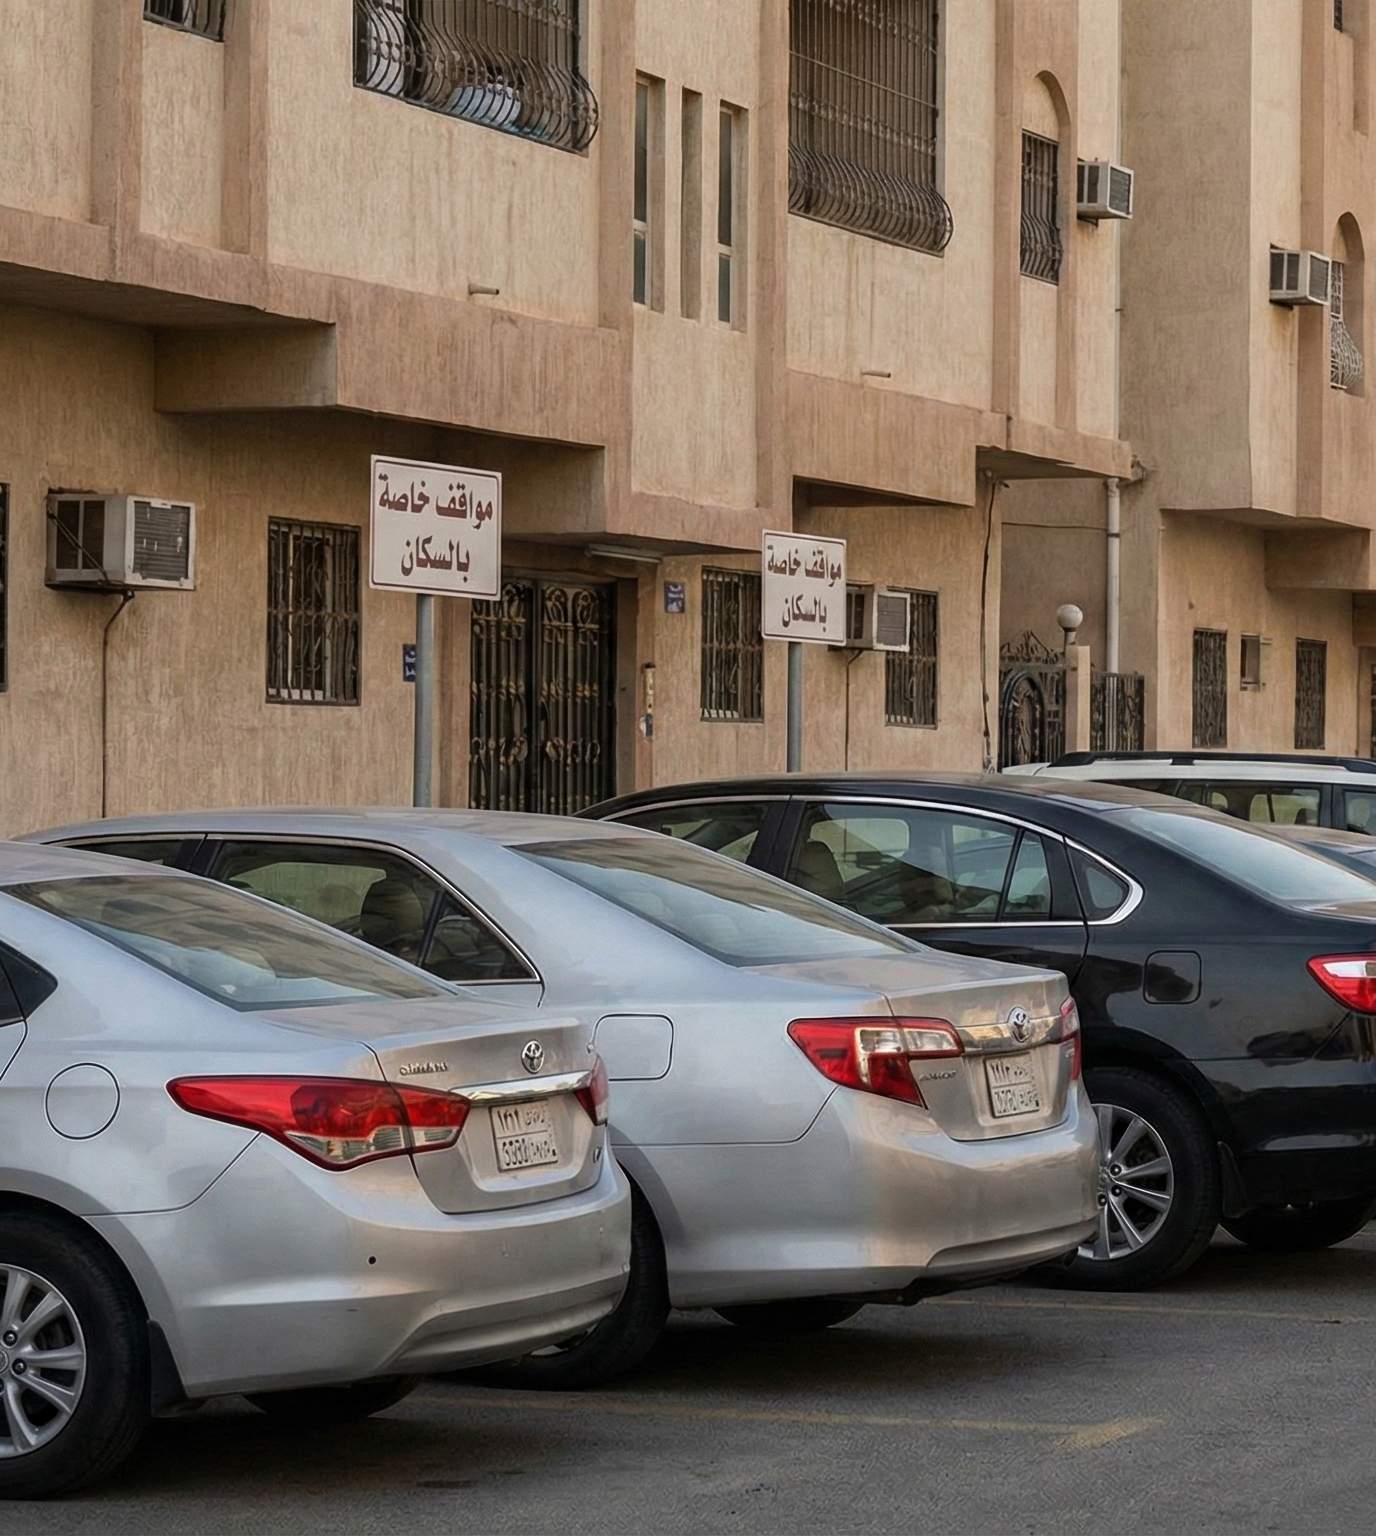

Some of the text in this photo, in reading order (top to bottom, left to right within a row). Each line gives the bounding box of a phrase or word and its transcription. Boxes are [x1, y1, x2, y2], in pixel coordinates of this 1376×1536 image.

[378, 473, 493, 530] مواقف خاصة
[401, 534, 470, 583] بالسكان
[767, 544, 842, 587] مواقف خاصة
[782, 594, 827, 632] بالسكان
